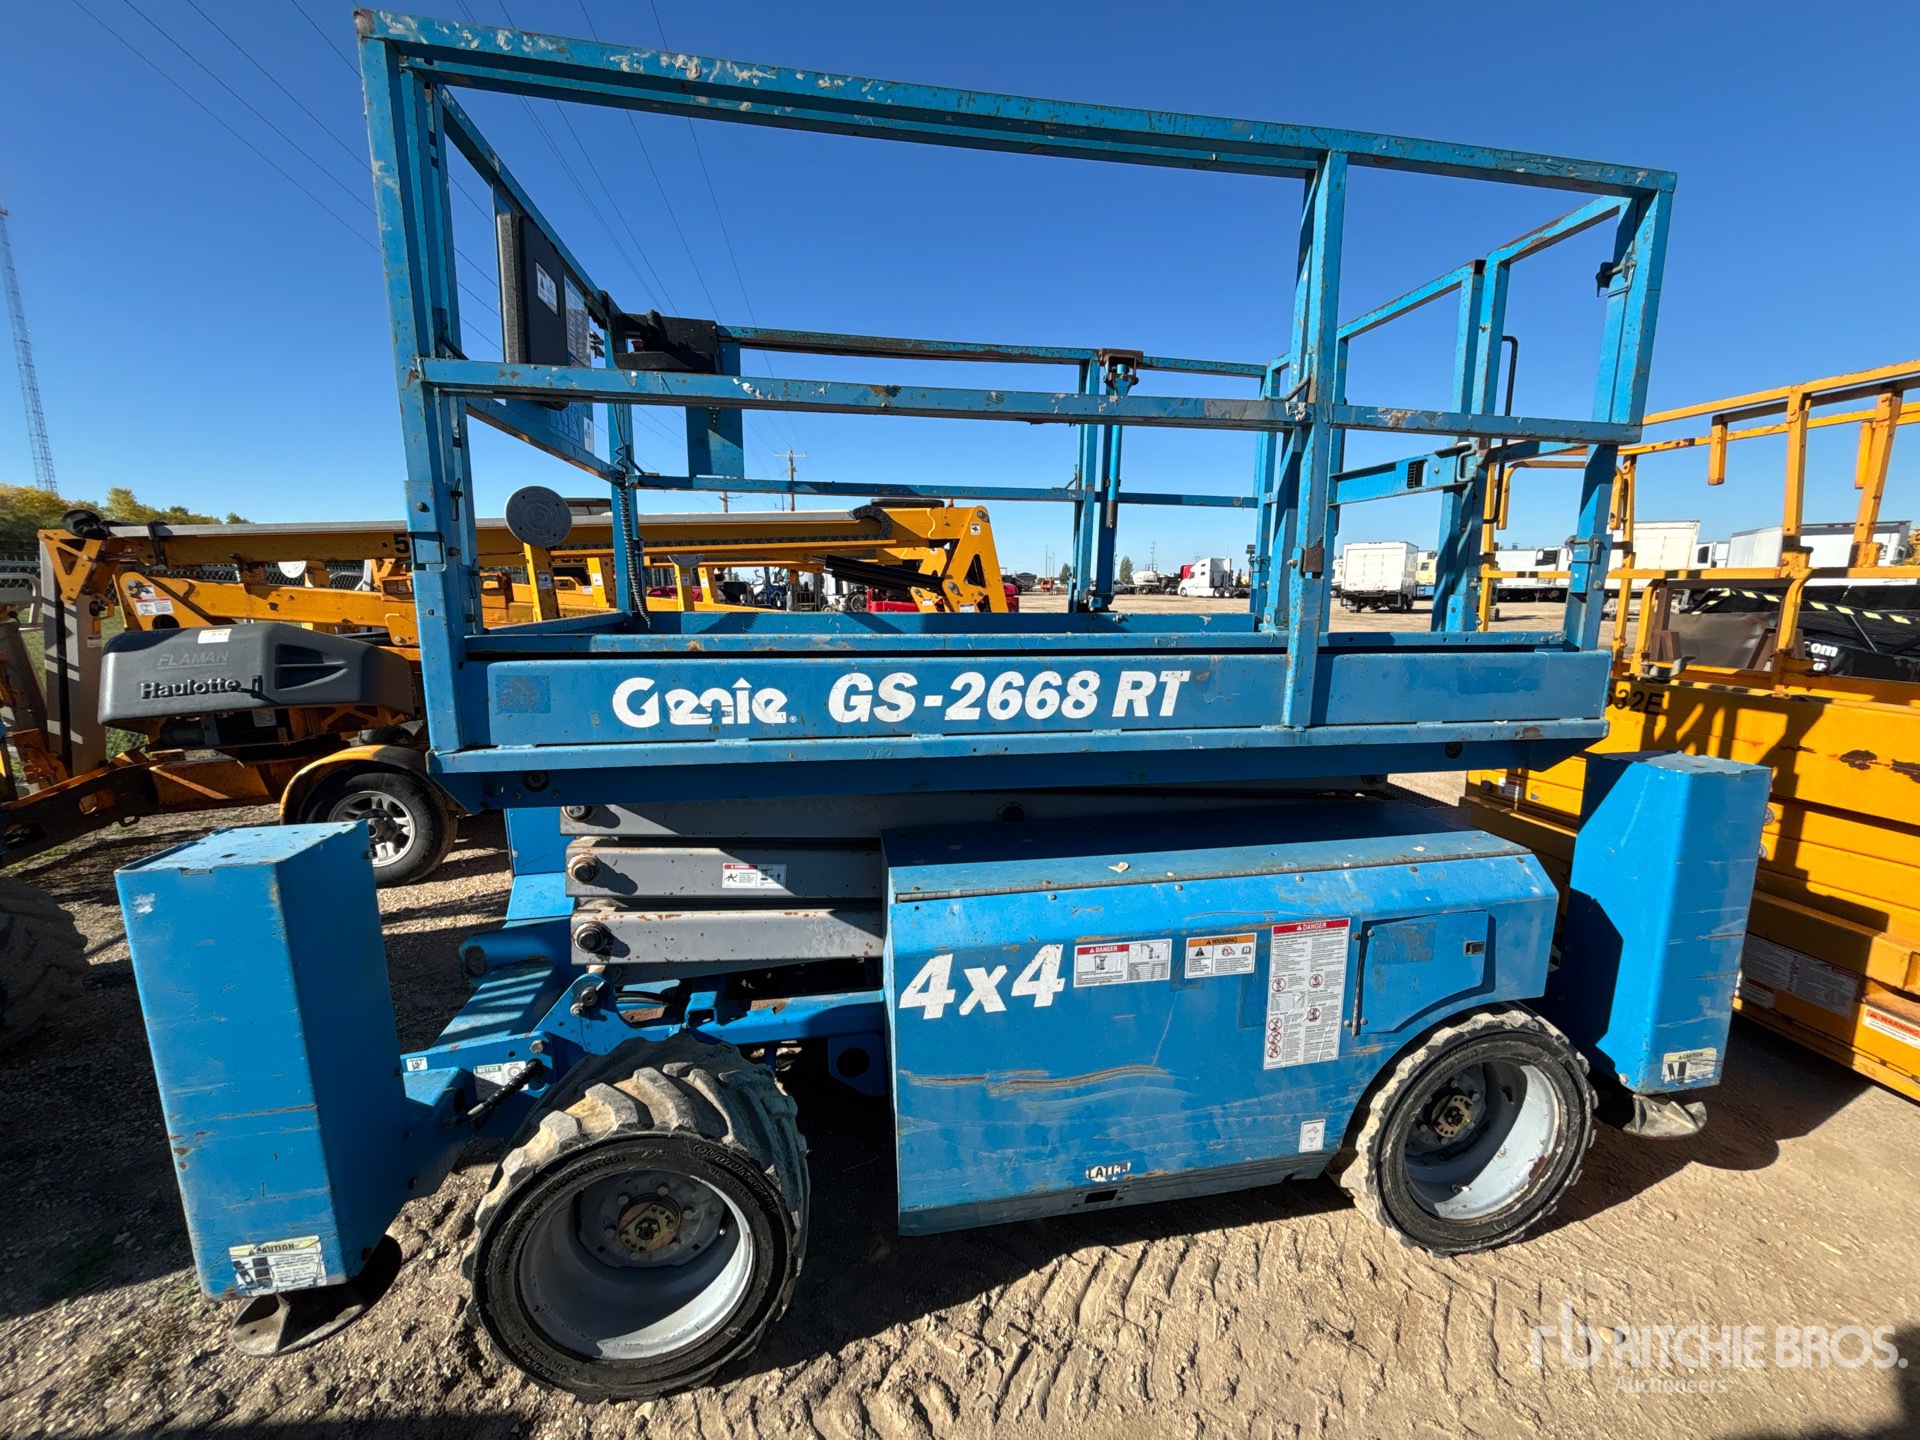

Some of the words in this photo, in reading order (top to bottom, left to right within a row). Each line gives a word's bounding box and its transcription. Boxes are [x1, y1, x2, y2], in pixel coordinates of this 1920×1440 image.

[158, 651, 229, 667] FLAMAN
[139, 677, 241, 699] Haulotte
[612, 677, 788, 728] Genie
[828, 670, 1100, 723] GS-2668
[1111, 670, 1191, 718] RT
[1303, 922, 1327, 931] DANGER
[1211, 936, 1238, 945] WARNING
[1095, 945, 1118, 954] DANGER
[898, 944, 1066, 1020] 4x4
[477, 1066, 499, 1074] NOTICE
